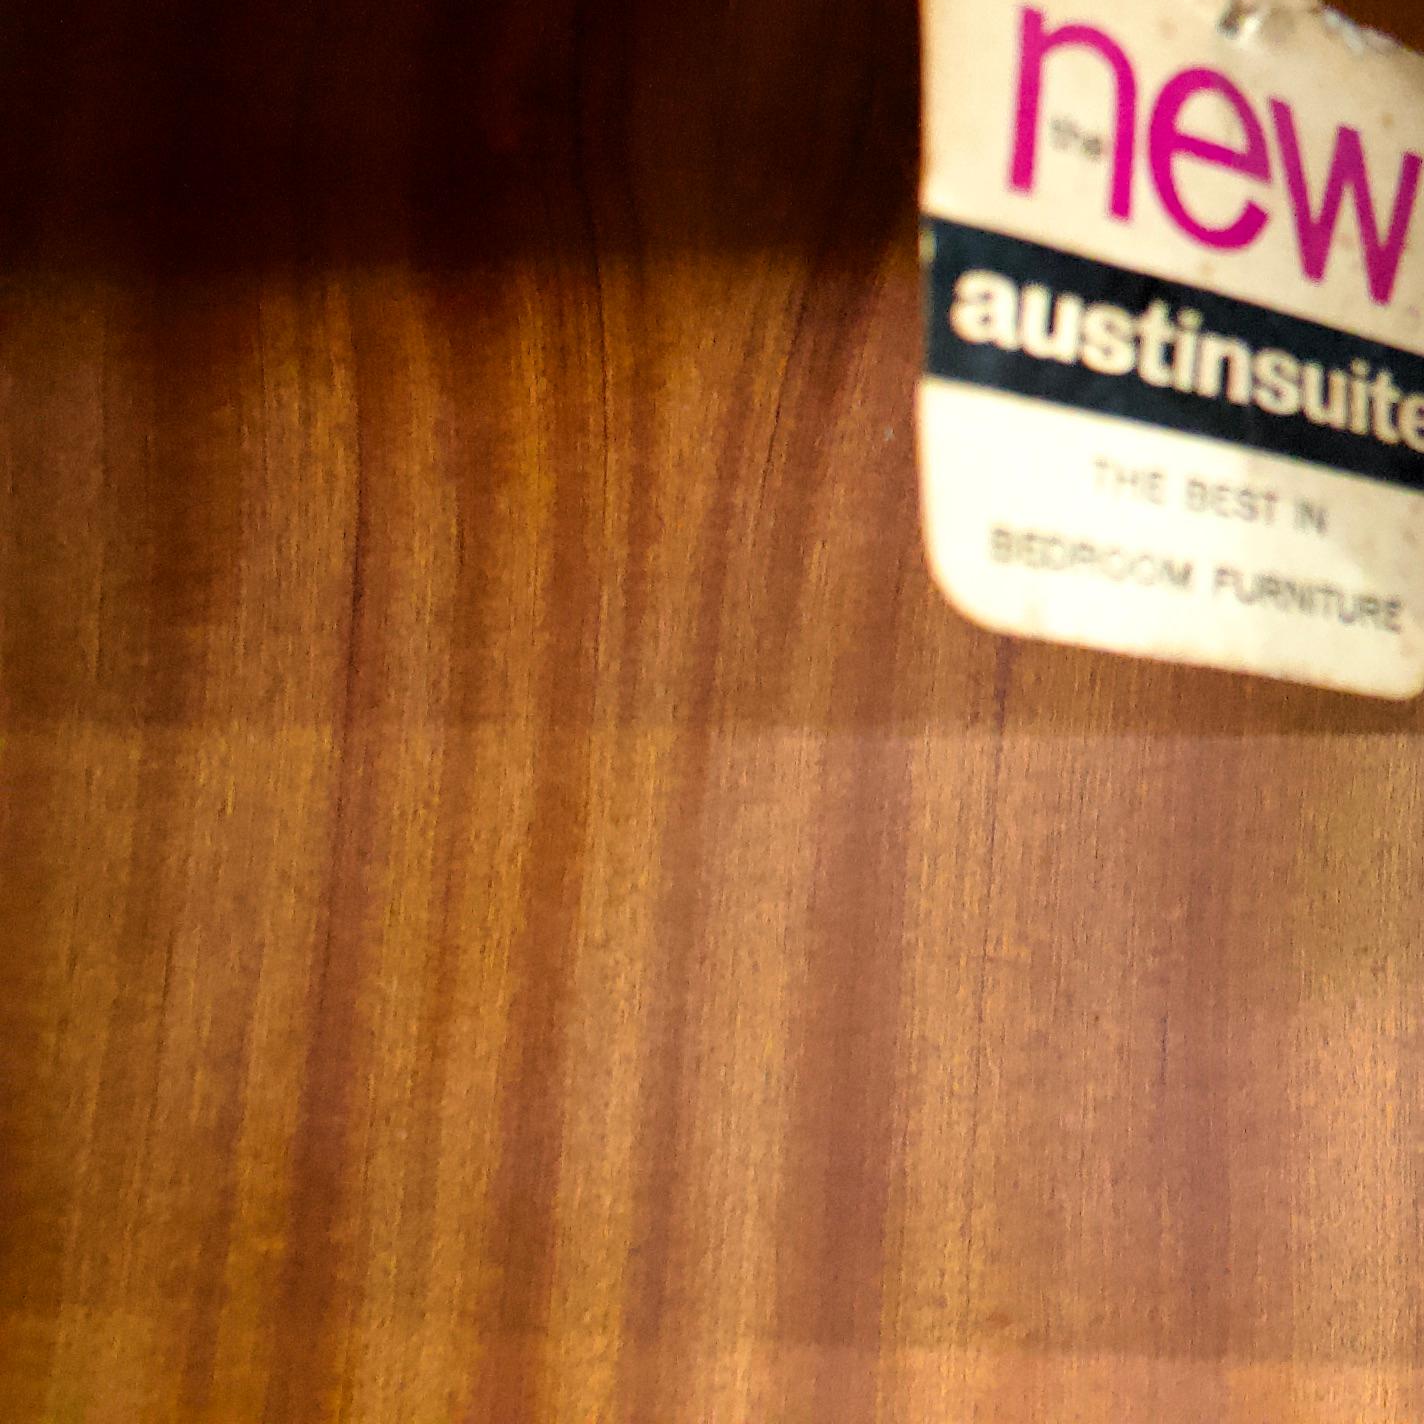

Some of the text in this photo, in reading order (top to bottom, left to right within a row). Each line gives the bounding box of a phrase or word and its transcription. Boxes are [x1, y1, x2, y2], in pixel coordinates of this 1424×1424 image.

[1009, 5, 1423, 305] new
[1094, 458, 1328, 535] THE BEST IN
[991, 526, 1402, 635] BEDROOM FURNITURE
